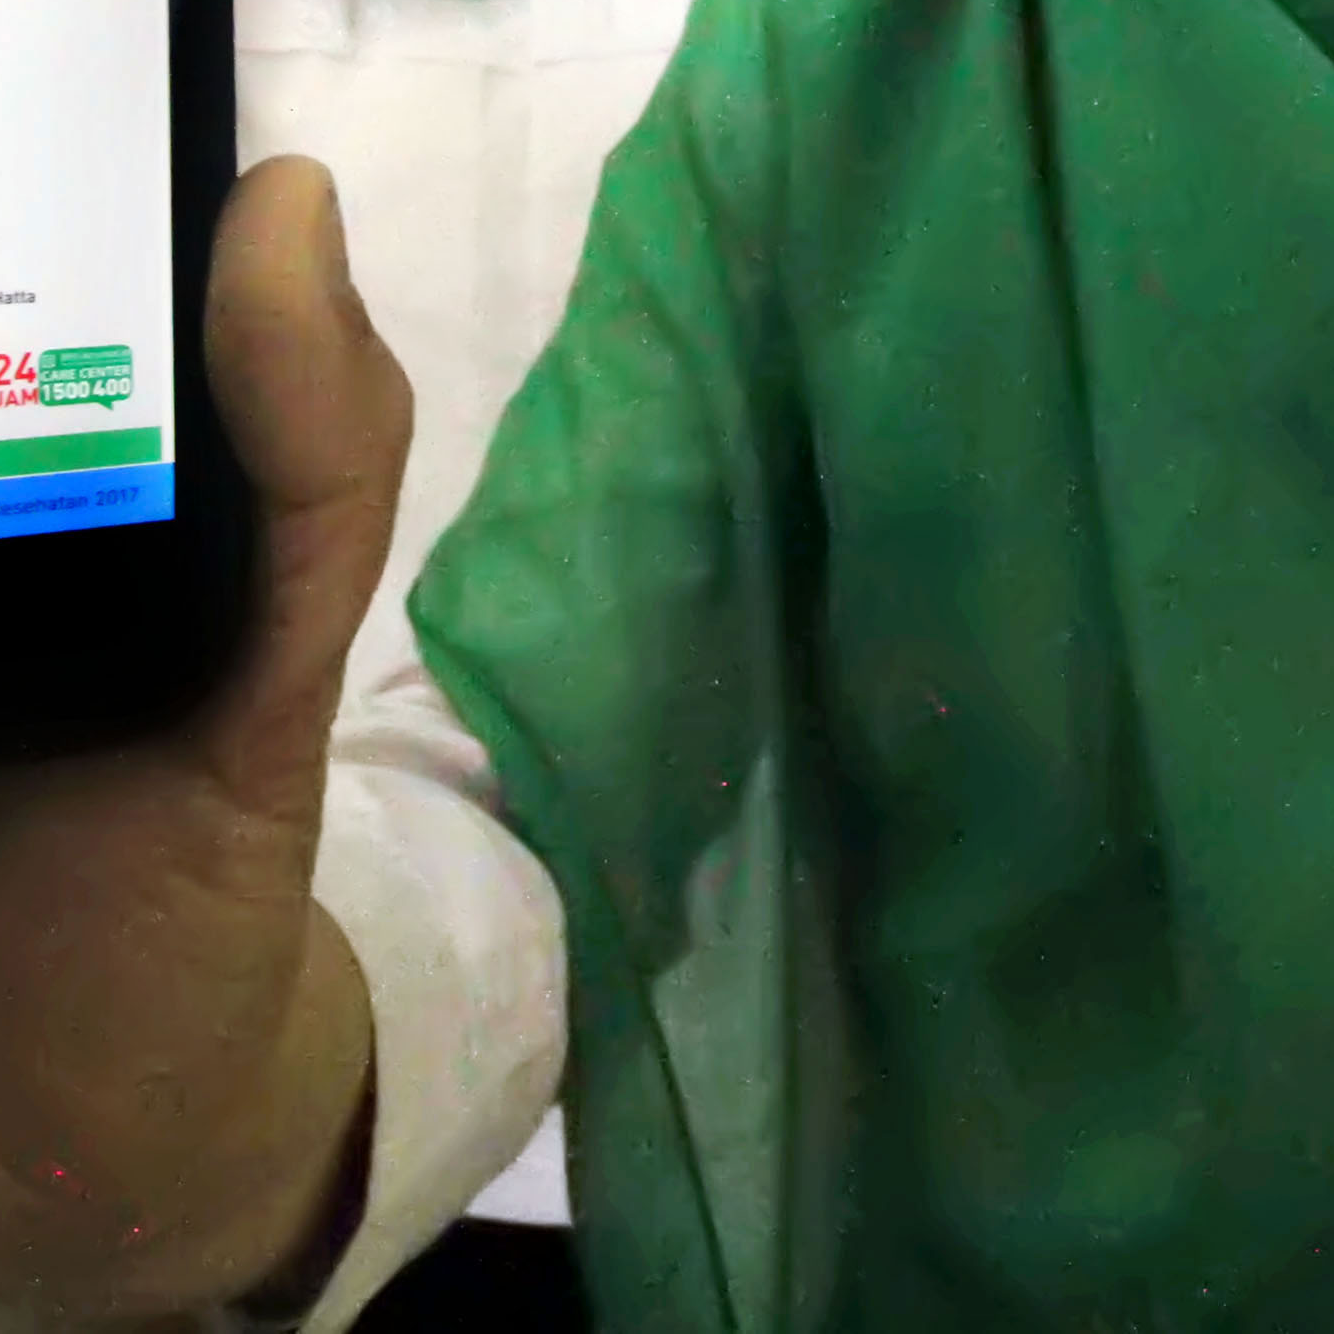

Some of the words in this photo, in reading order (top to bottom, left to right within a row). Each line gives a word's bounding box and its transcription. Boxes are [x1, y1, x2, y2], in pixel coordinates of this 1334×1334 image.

[42, 381, 90, 401] 1500
[93, 378, 130, 396] 400
[95, 487, 139, 507] 2017
